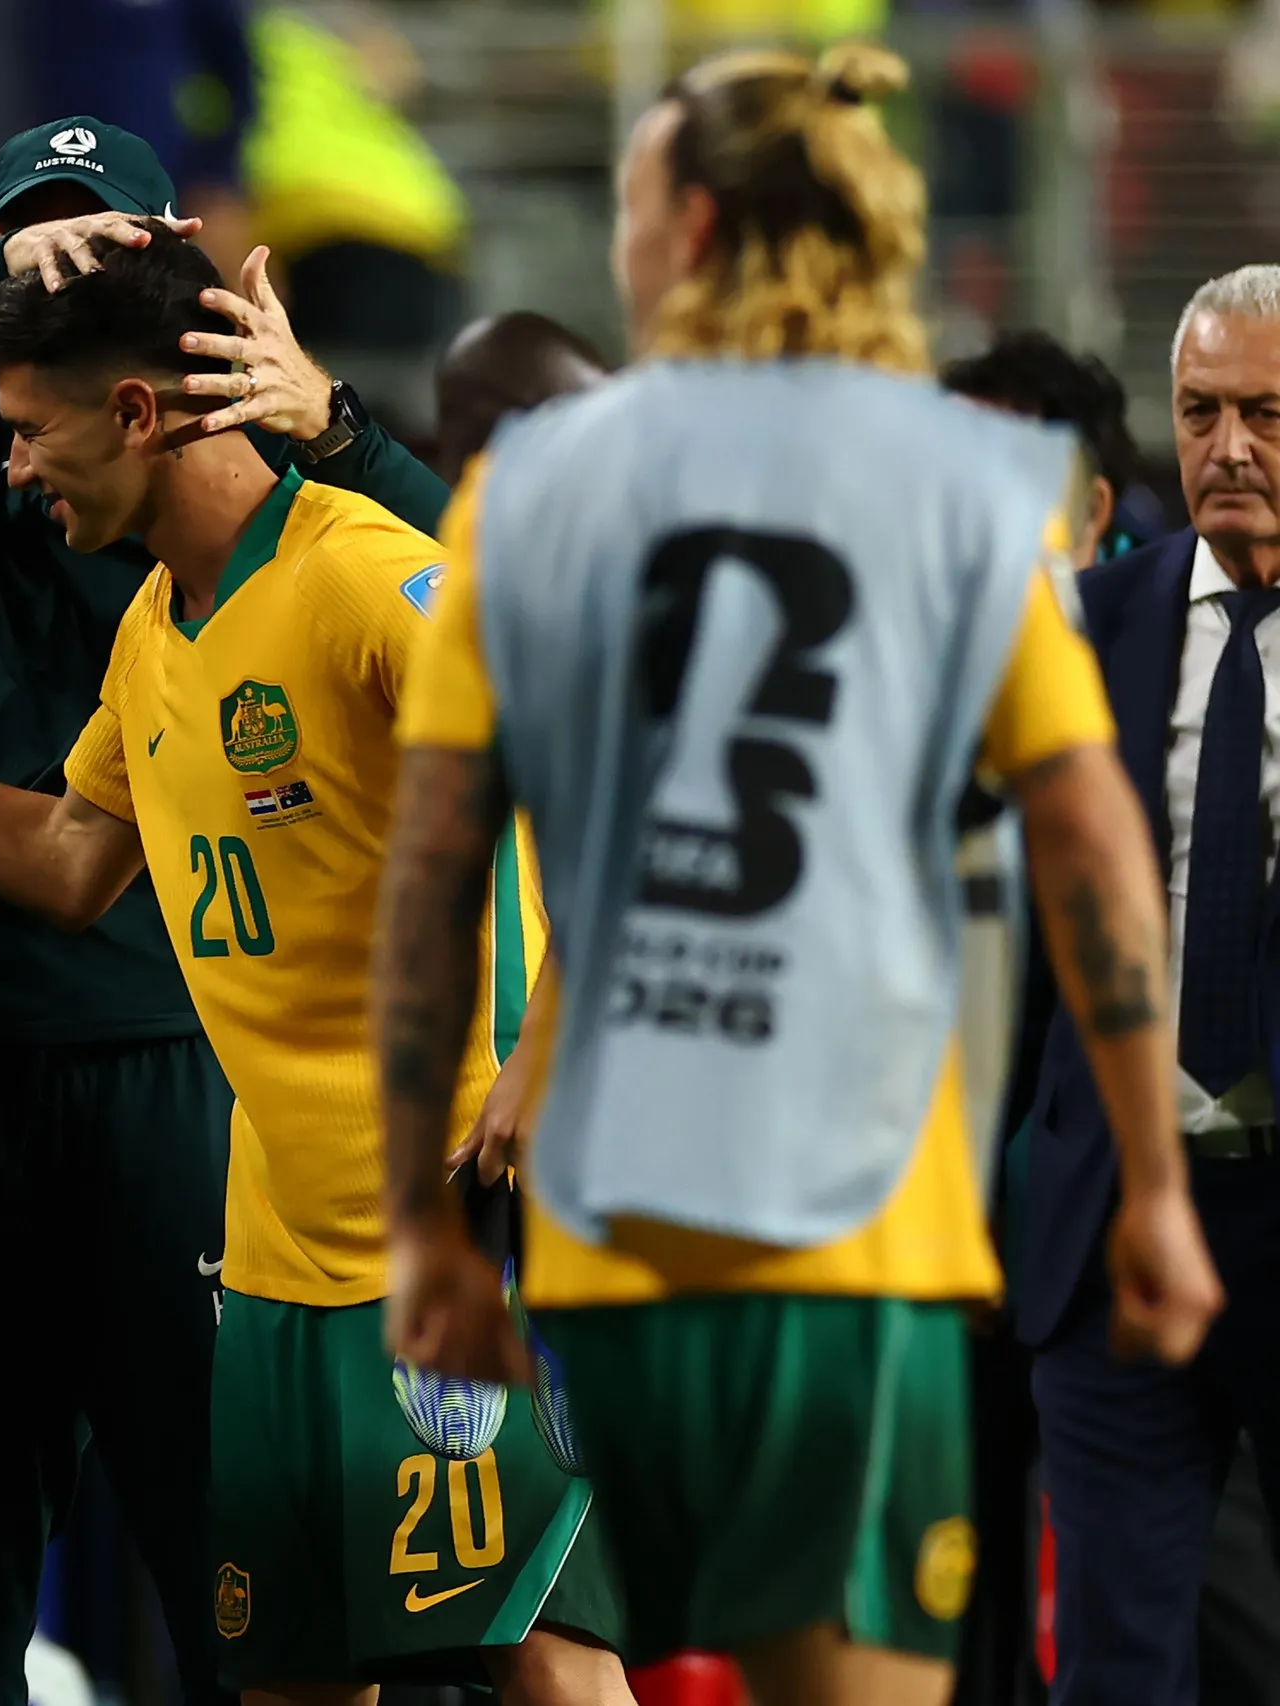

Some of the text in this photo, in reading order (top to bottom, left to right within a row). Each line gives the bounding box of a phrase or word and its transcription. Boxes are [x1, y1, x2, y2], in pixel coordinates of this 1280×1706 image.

[34, 156, 104, 173] AUSTRALIA
[234, 733, 286, 753] AUSTRALIA
[190, 834, 276, 958] 20
[389, 1447, 505, 1575] 20
